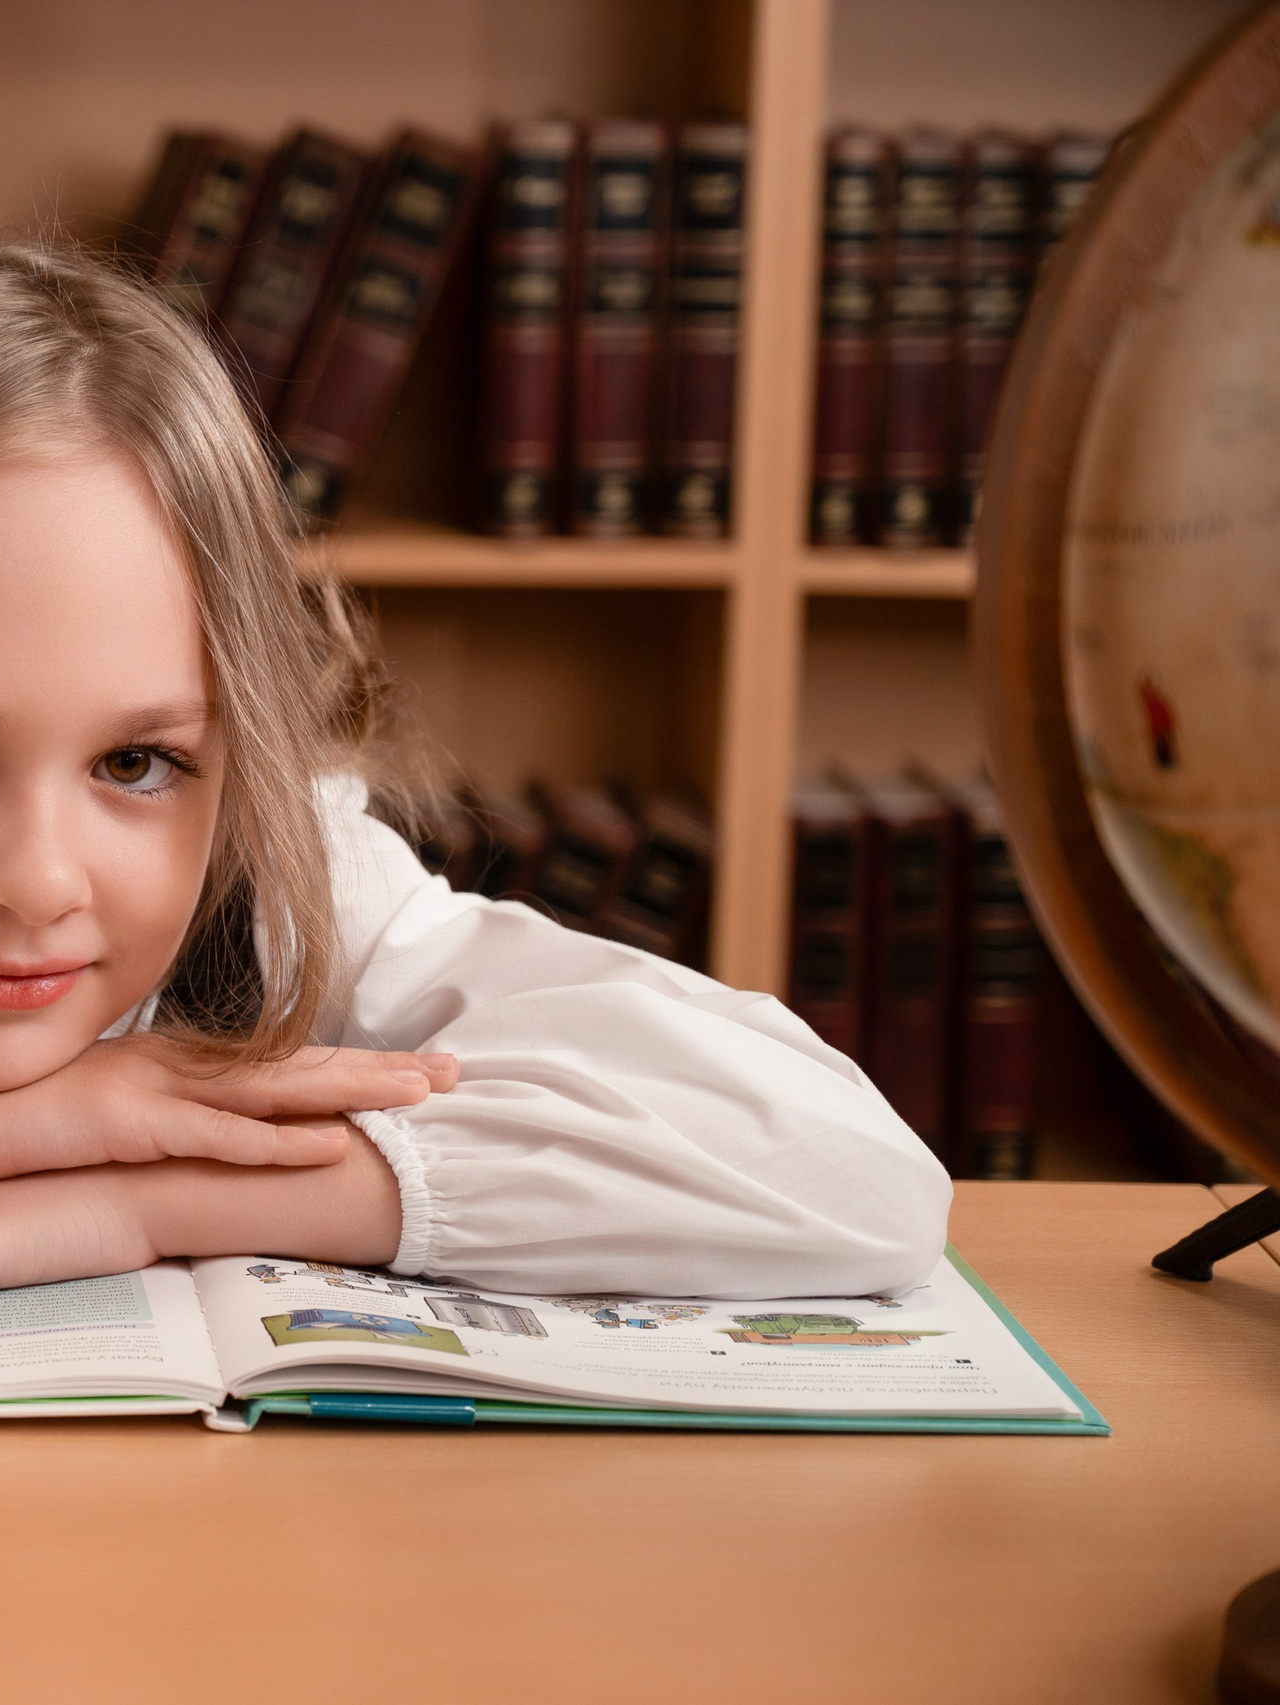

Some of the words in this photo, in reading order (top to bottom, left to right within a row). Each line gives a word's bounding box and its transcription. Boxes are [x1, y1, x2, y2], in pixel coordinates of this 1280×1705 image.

[97, 1353, 164, 1362] Бумагу
[711, 1382, 824, 1393] бумажному
[859, 1386, 998, 1394] Переработка:
